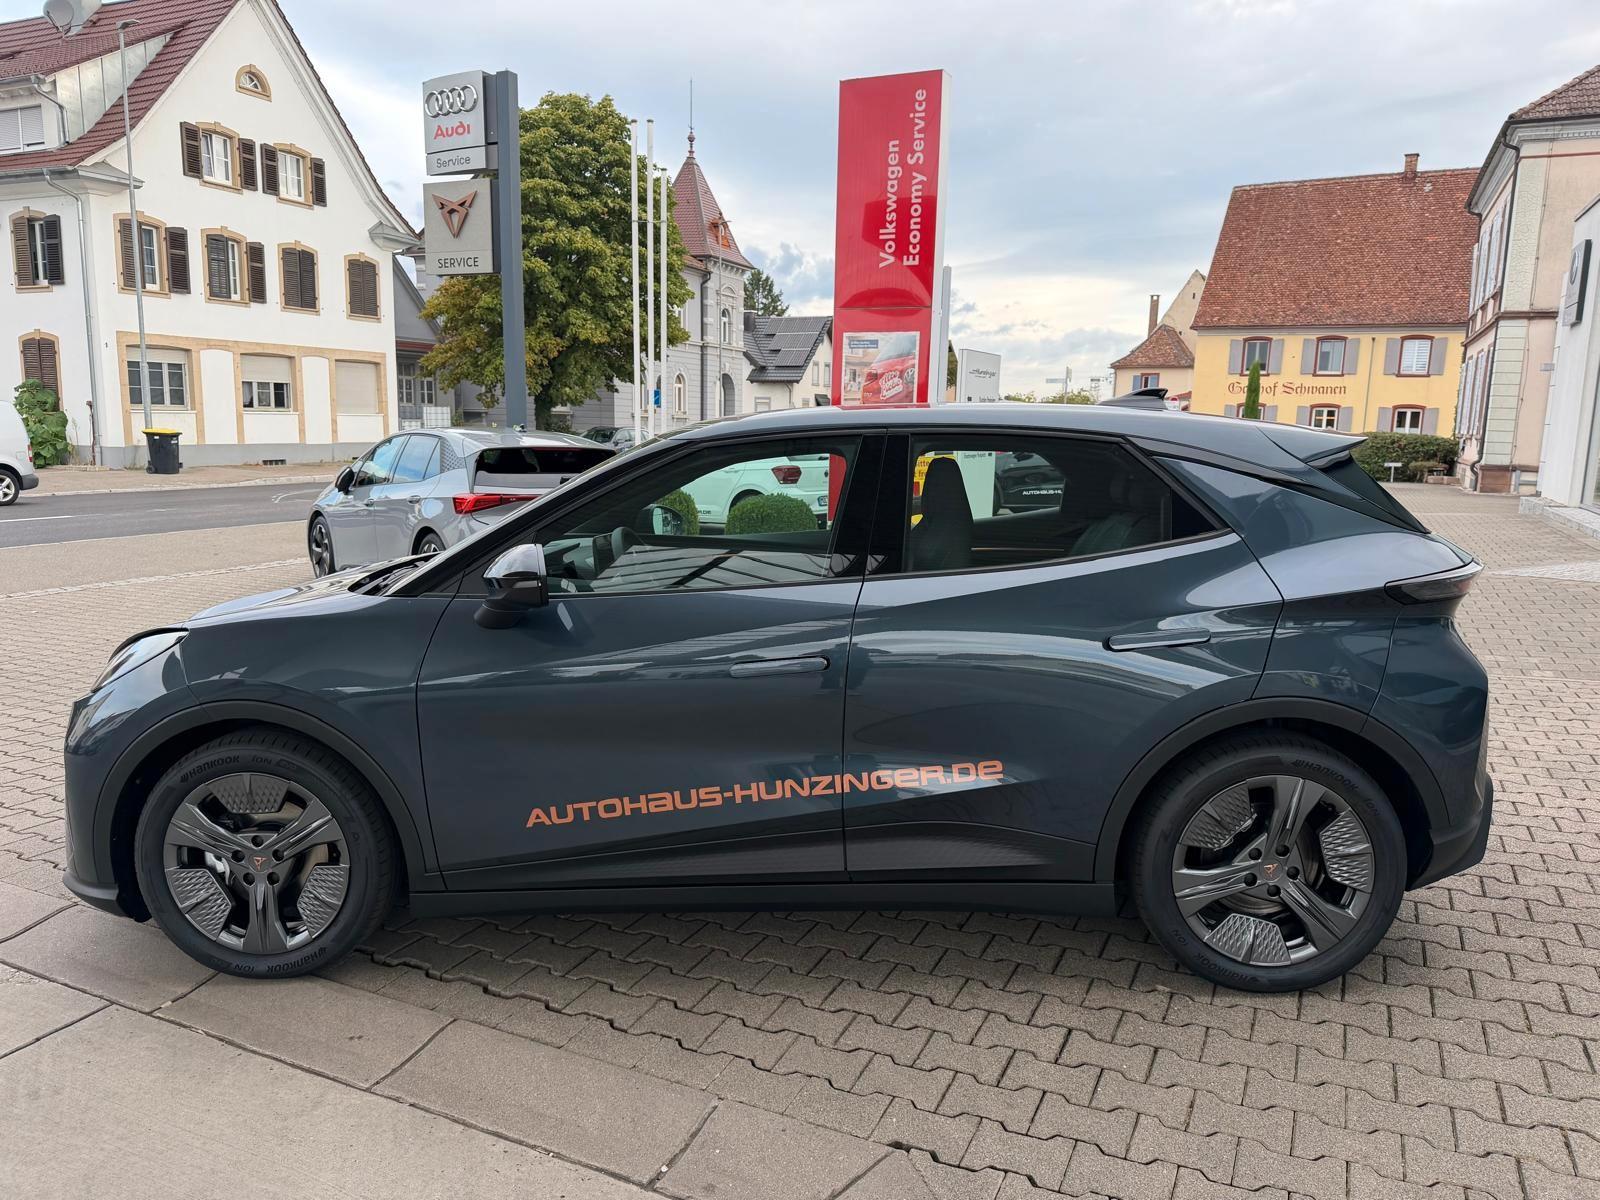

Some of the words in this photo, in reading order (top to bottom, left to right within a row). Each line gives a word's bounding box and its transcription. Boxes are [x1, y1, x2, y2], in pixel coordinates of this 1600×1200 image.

[433, 121, 471, 140] Audi
[906, 88, 928, 165] Service
[436, 155, 471, 169] Service
[879, 139, 903, 269] Volkswagen
[903, 171, 928, 267] Economy
[437, 256, 479, 269] SERVICE
[1282, 381, 1347, 396] Schwanen
